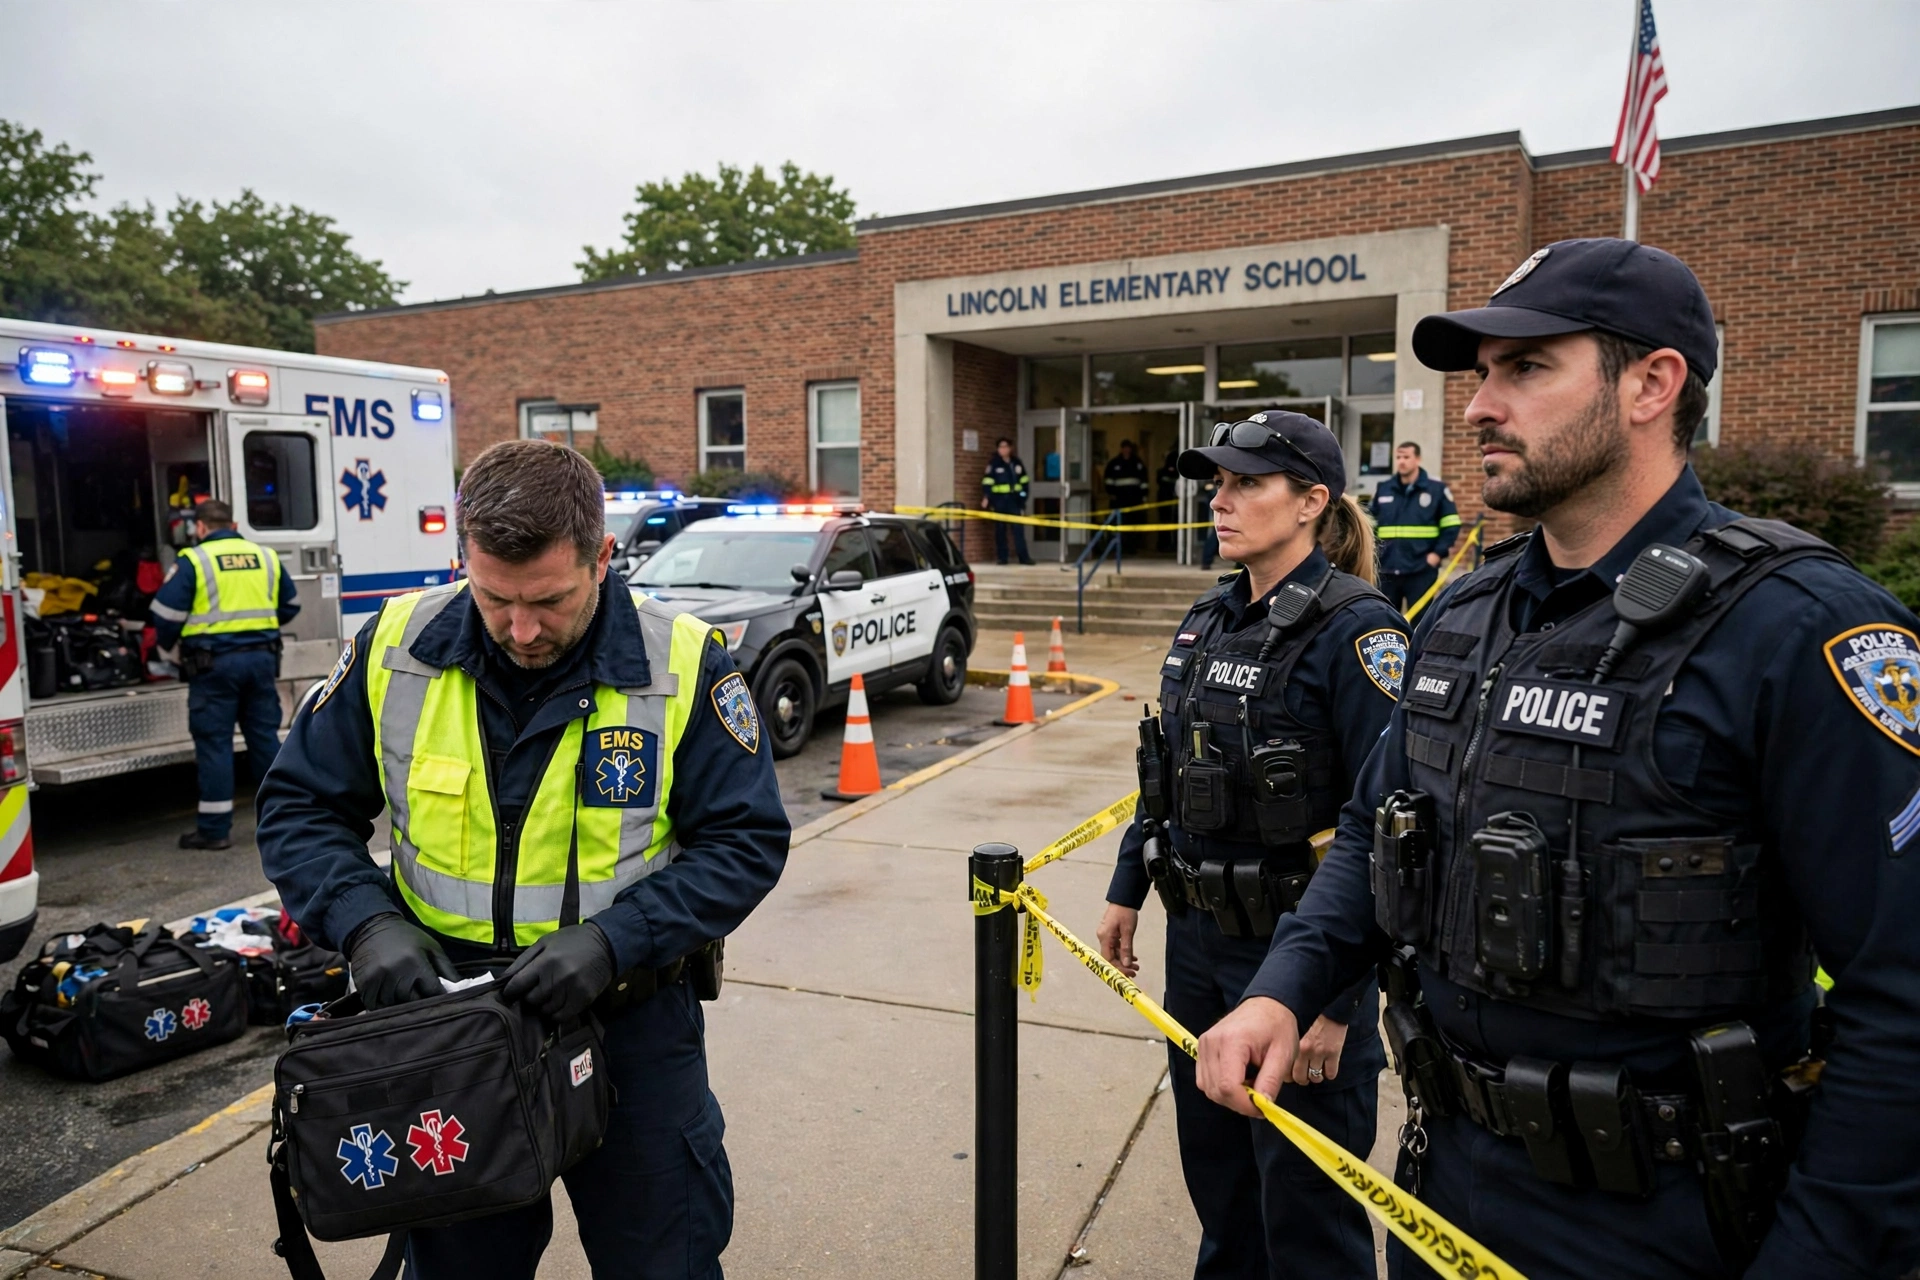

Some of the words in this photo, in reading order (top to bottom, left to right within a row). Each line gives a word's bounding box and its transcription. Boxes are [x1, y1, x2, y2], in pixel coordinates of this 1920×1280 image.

[947, 284, 1047, 316] LINCOLN
[1059, 266, 1230, 308] ELEMENTARY
[1244, 253, 1366, 291] SCHOOL
[221, 555, 257, 569] EMT
[851, 610, 916, 650] POLICE
[1848, 632, 1906, 654] POLICE
[1206, 660, 1262, 690] POLICE
[1502, 685, 1609, 736] POLICE
[599, 730, 644, 750] EMS
